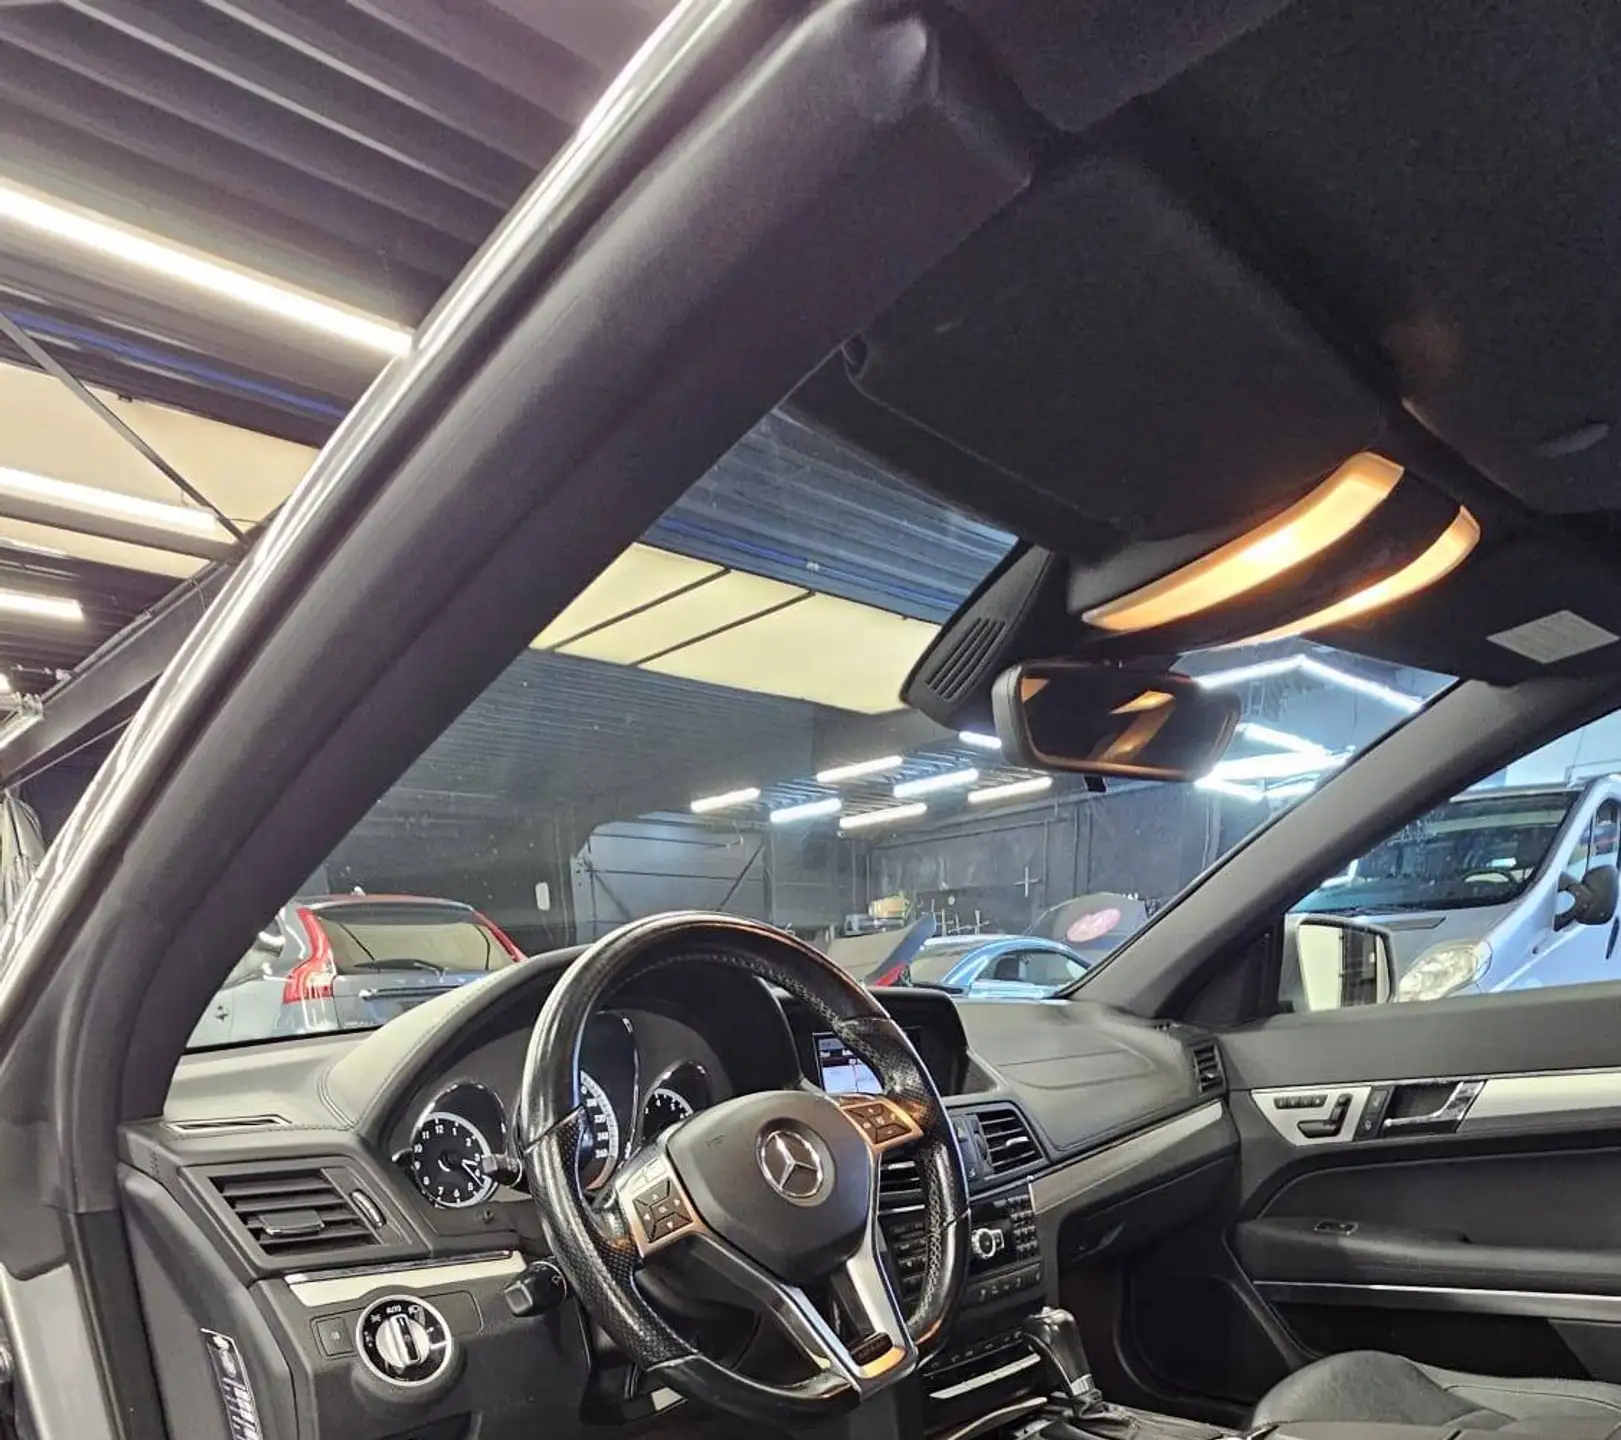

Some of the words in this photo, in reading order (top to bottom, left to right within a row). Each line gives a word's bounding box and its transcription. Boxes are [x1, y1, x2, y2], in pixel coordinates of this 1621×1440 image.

[435, 1125, 444, 1134] 12
[422, 1131, 430, 1139] 11
[414, 1143, 422, 1153] 10
[438, 1186, 444, 1195] 7
